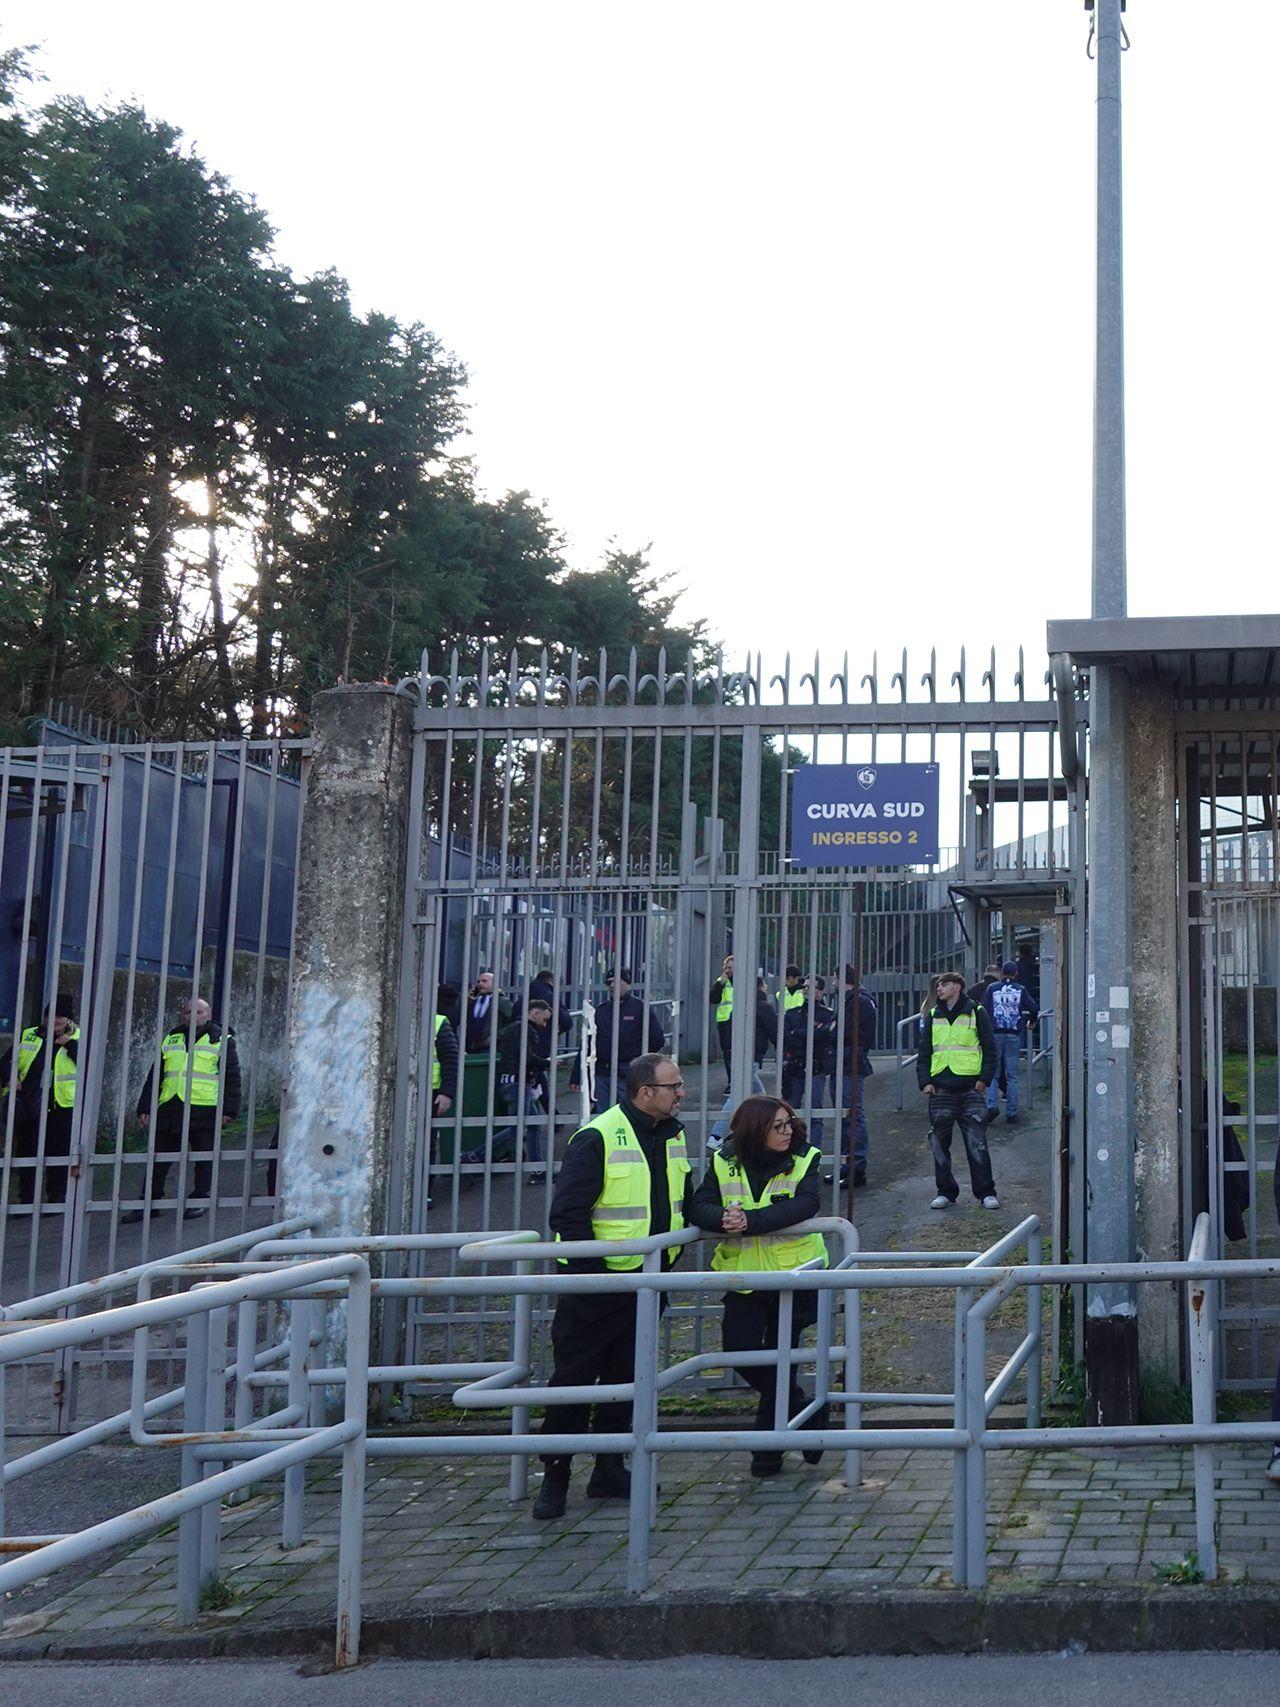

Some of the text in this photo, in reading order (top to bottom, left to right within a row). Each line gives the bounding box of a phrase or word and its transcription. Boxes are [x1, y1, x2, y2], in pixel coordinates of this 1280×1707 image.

[807, 802, 925, 819] CURVA SUD
[812, 830, 918, 845] INGRESSO 2
[616, 1135, 627, 1146] 11
